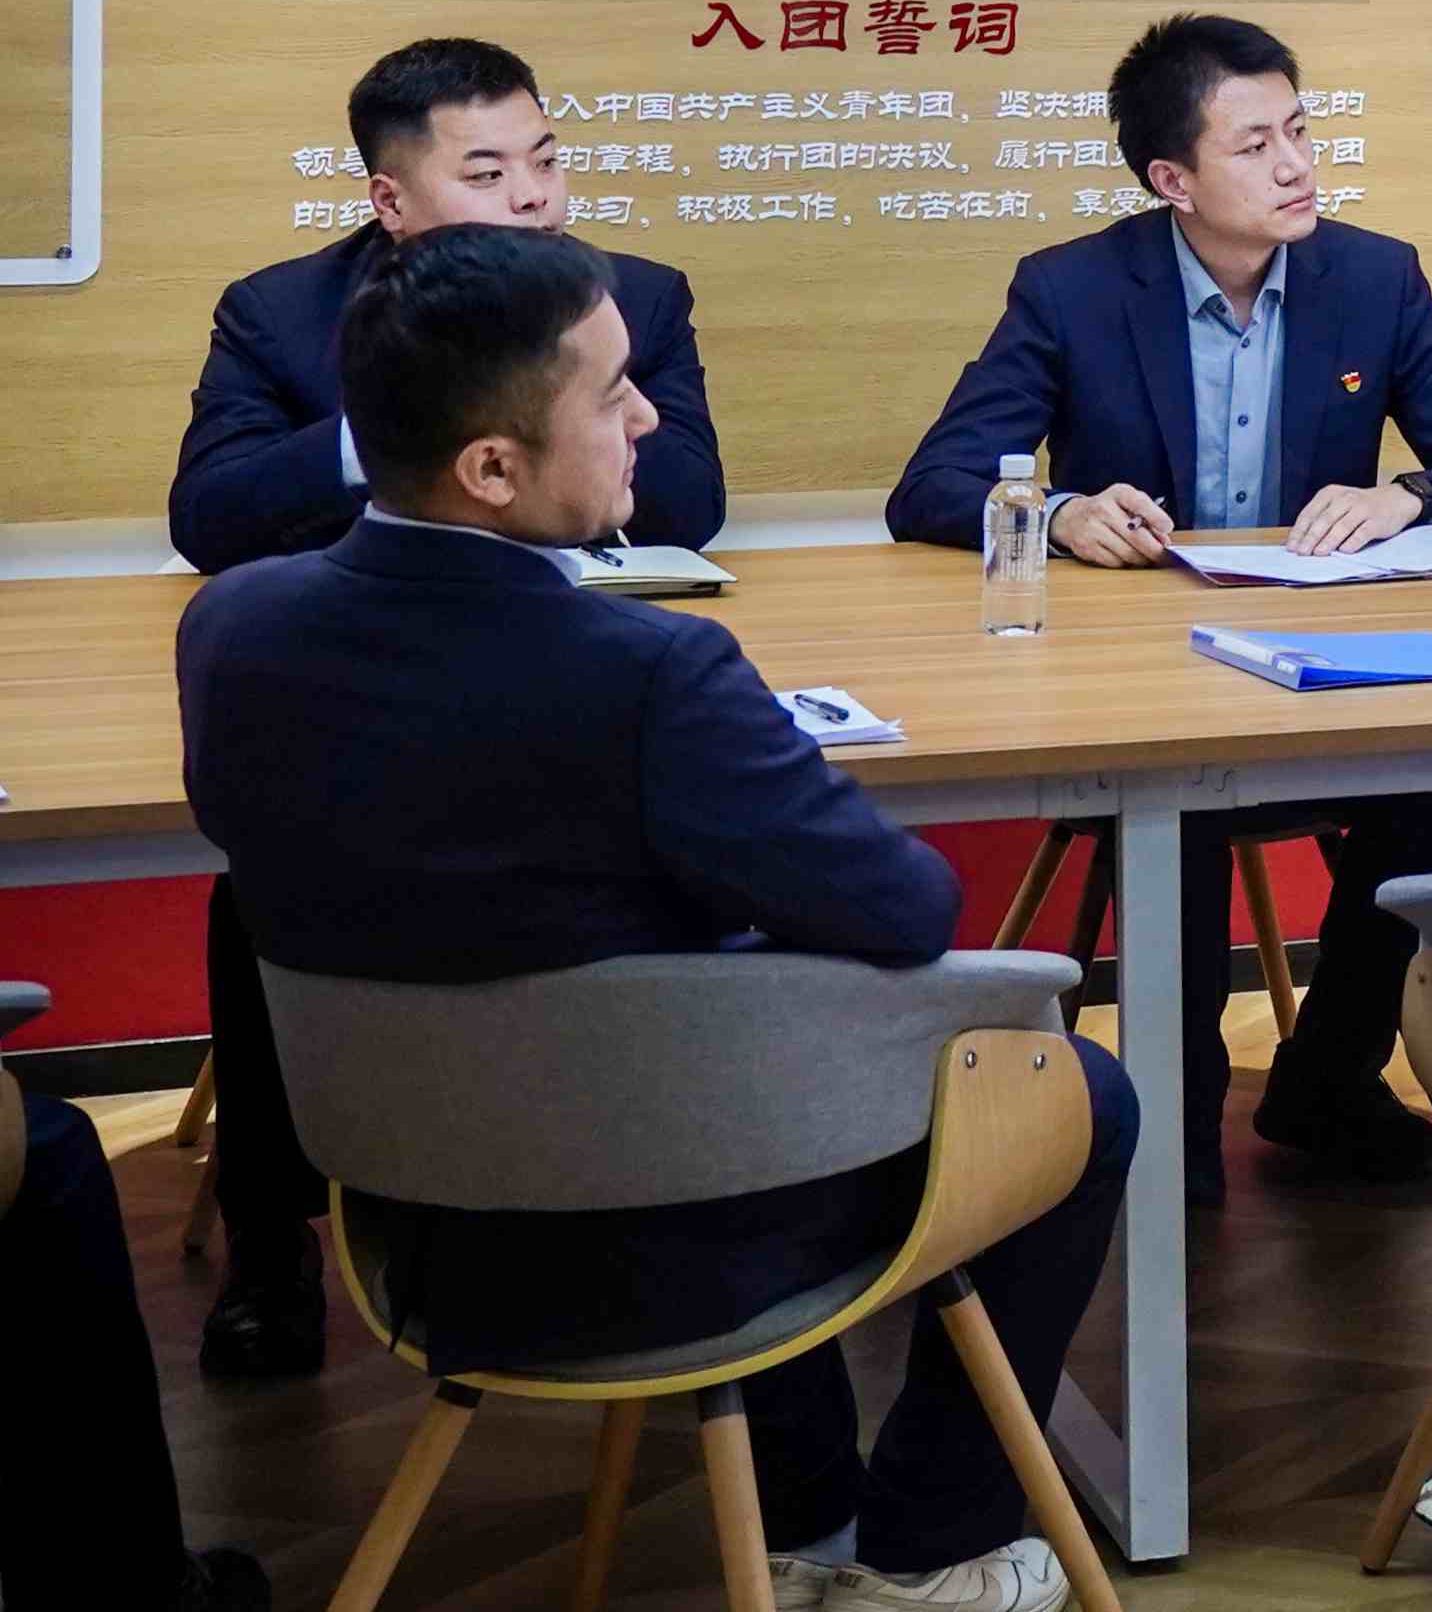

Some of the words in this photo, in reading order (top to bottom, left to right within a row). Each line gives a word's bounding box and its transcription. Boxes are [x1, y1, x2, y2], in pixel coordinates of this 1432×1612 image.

[691, 0, 1019, 56] 入团誓词
[565, 188, 1168, 228] 学习，积极工作，吃苦在前，享受
